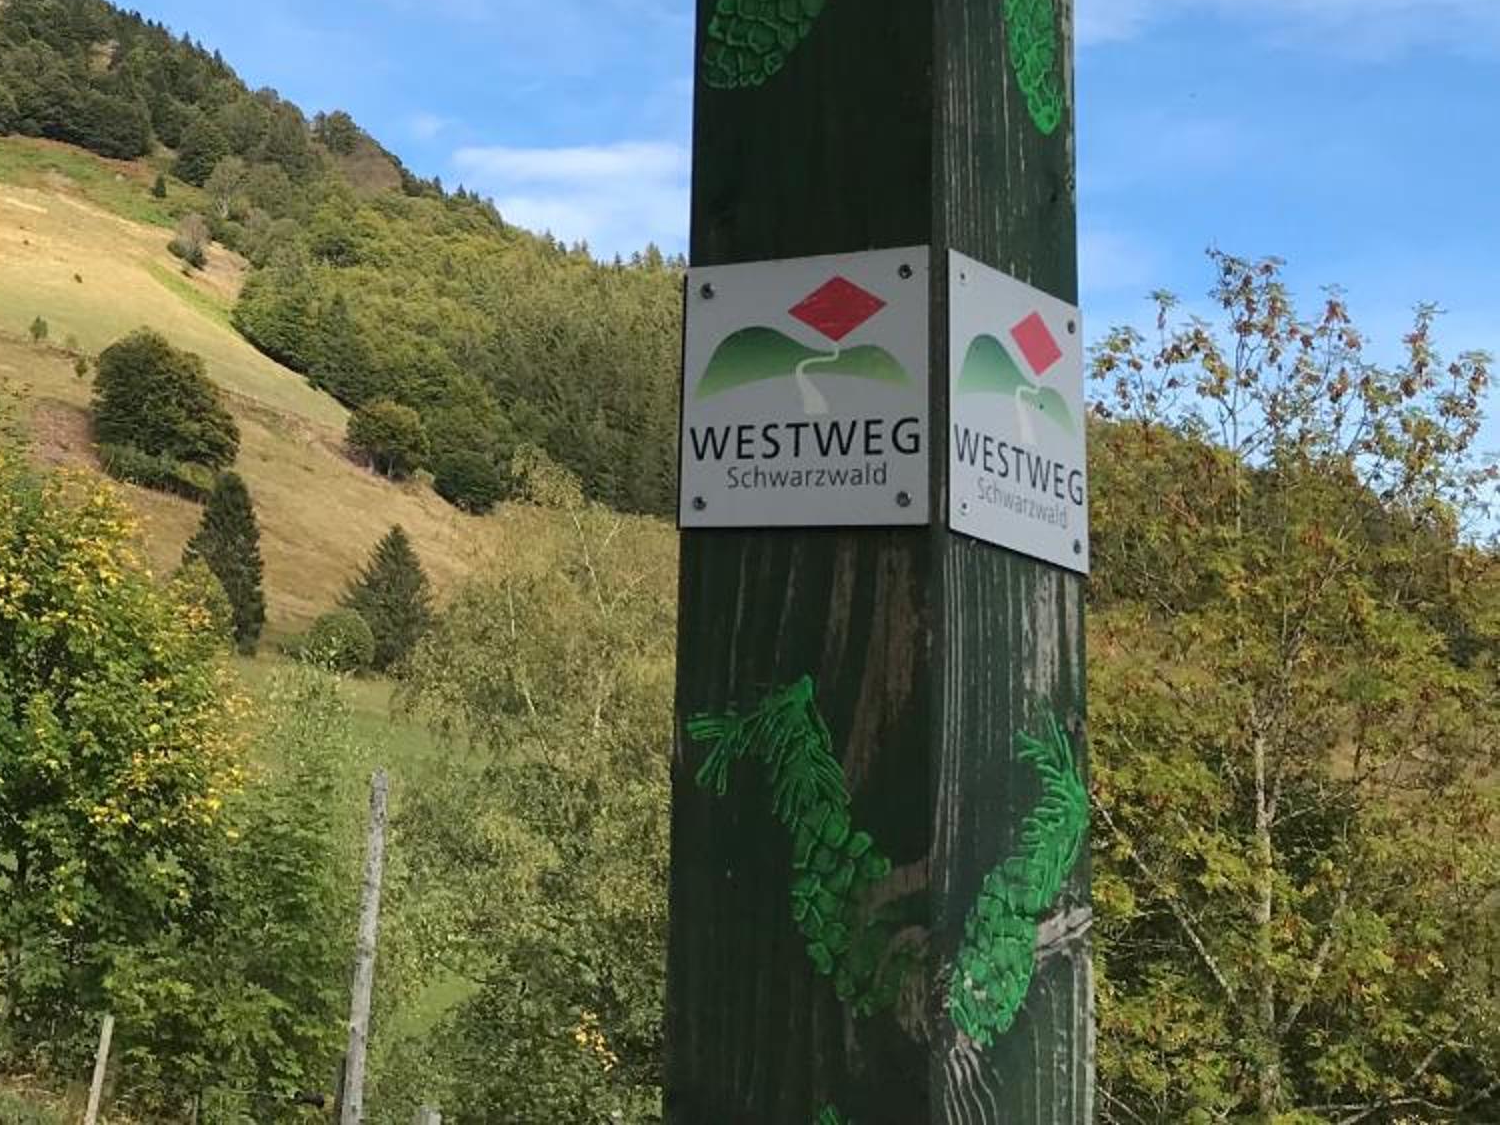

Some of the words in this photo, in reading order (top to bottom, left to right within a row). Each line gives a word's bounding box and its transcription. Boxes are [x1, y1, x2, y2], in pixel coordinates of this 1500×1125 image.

[690, 417, 921, 460] WESTWEG
[726, 463, 888, 489] Schwarzwald
[954, 423, 1084, 507] WESTWEG
[977, 477, 1068, 530] Schwarzwald
